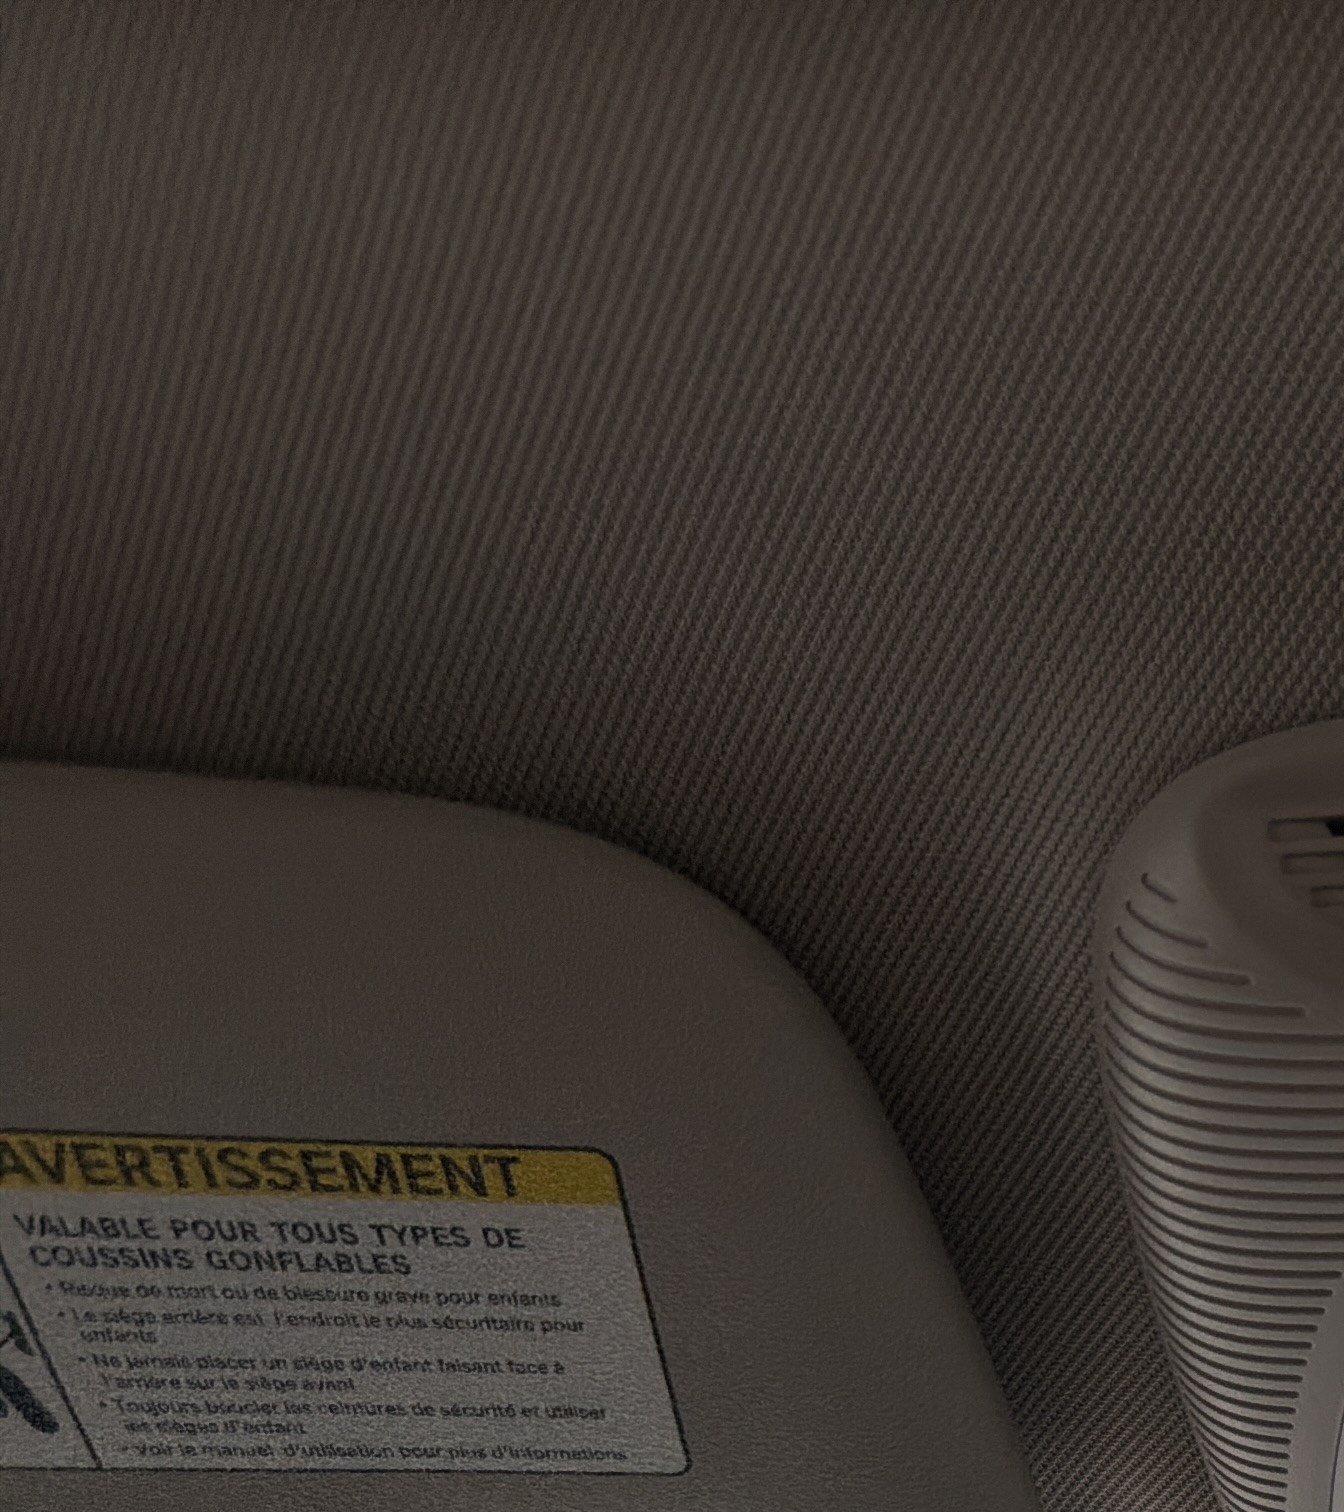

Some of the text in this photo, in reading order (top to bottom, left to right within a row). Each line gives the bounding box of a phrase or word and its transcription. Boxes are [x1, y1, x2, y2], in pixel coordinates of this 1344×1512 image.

[0, 1139, 520, 1198] AVERTISSEMENT
[13, 1214, 526, 1250] VALABLE POUR TOUS TYPES DE
[29, 1245, 412, 1276] COUSSINS GONFLABLES
[437, 1293, 481, 1308] pour
[542, 1319, 584, 1335] pour
[399, 1447, 443, 1461] pour
